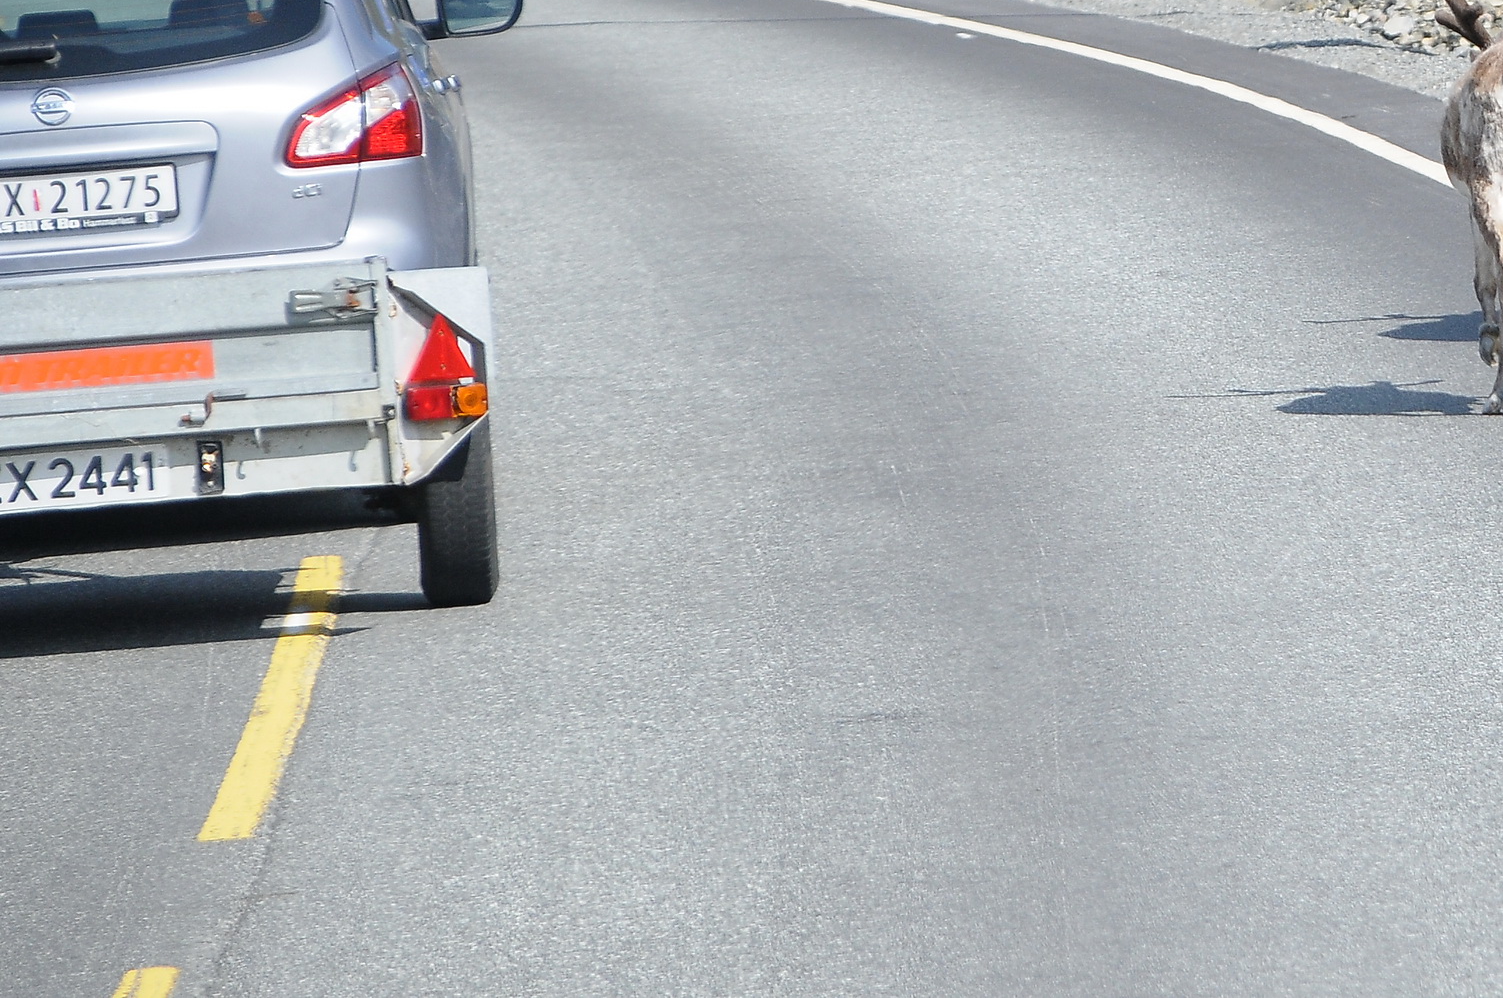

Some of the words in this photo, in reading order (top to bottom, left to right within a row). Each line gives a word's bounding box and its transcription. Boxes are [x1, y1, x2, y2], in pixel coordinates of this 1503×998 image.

[50, 174, 161, 214] 21275
[0, 461, 38, 503] X
[48, 452, 154, 499] 2441
